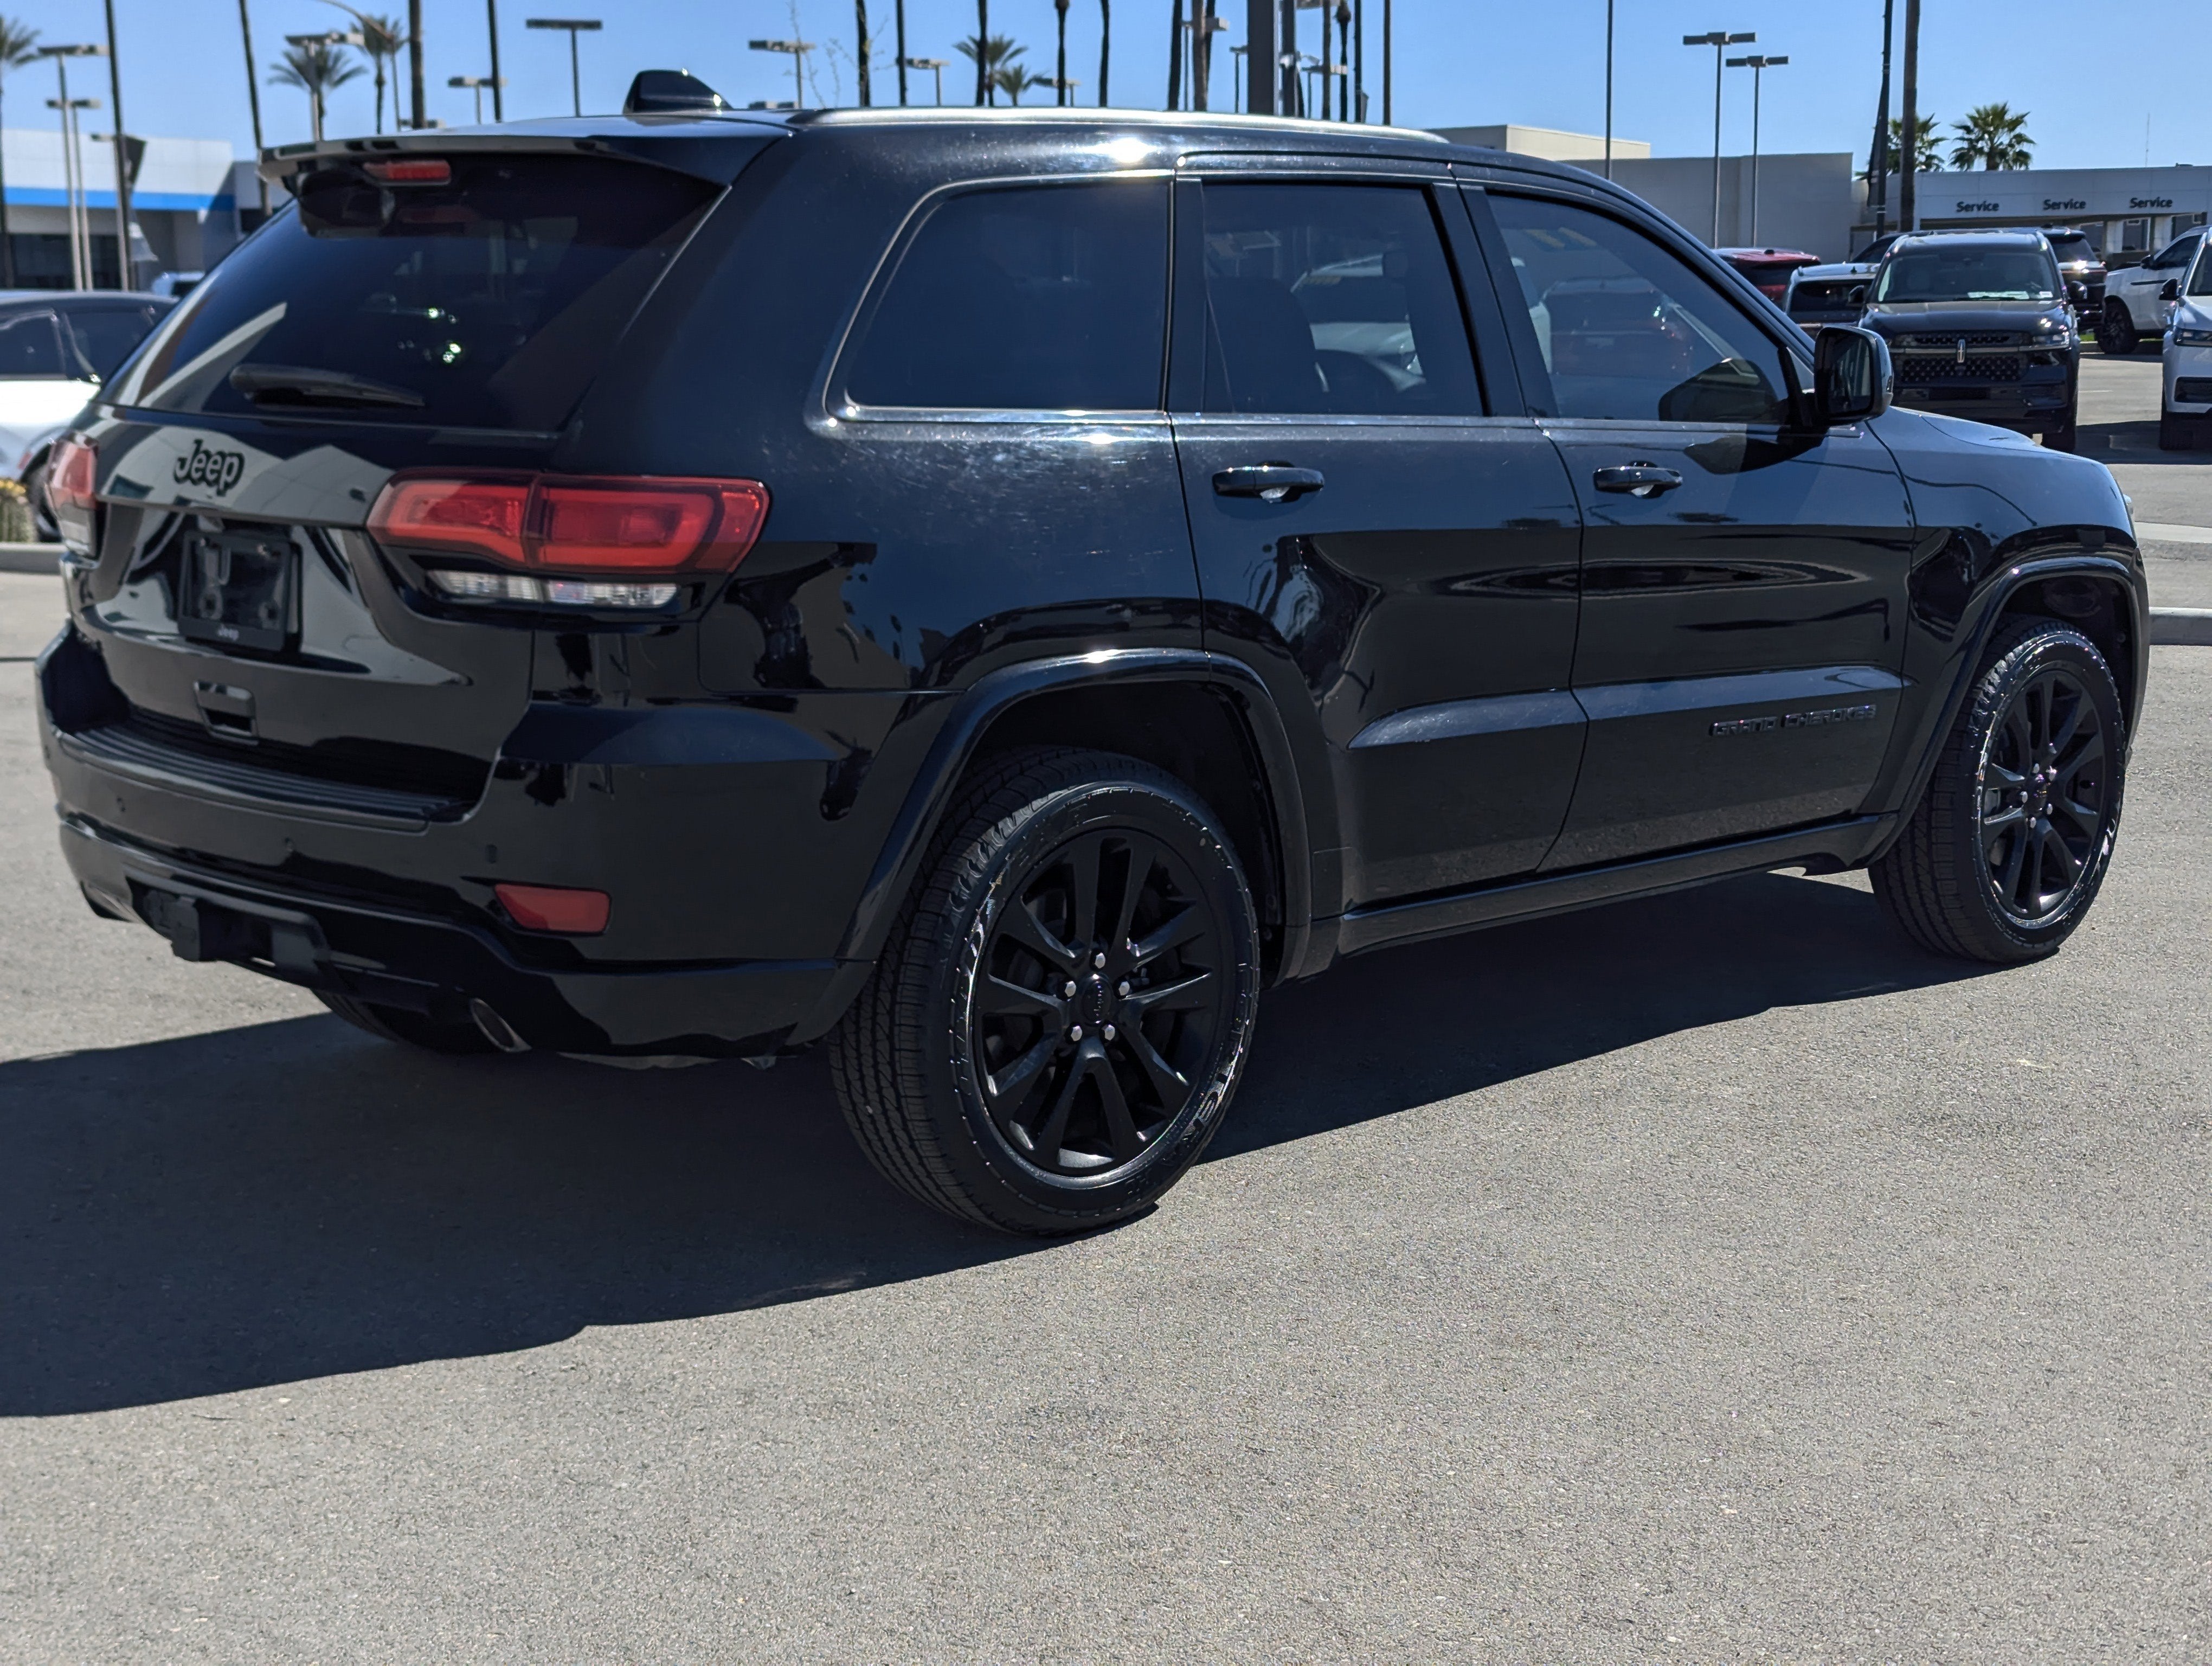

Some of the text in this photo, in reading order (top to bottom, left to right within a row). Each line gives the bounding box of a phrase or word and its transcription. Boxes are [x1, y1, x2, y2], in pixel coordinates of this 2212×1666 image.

[1956, 200, 1999, 212] Service
[2043, 198, 2086, 210] Service
[2129, 197, 2172, 208] Service
[173, 439, 245, 496] Jeep
